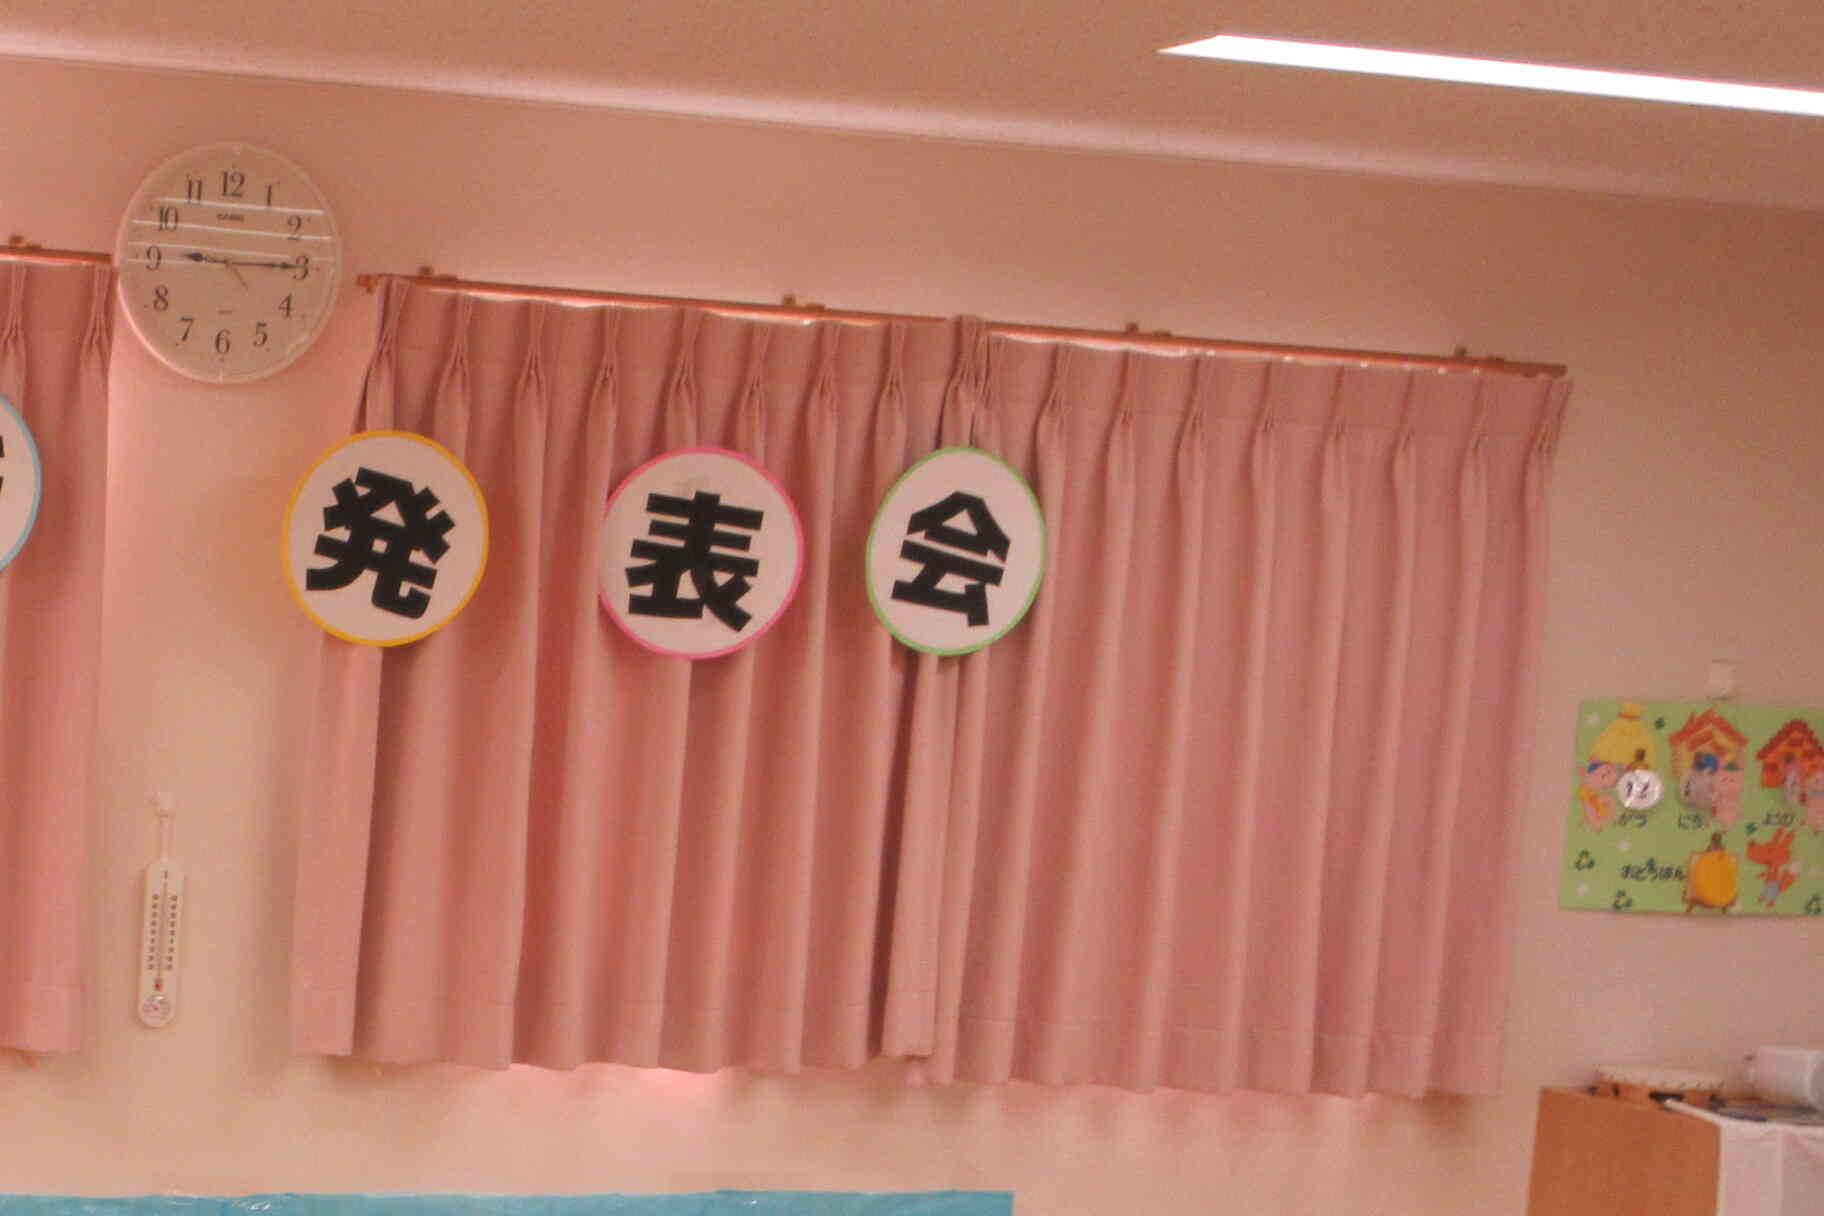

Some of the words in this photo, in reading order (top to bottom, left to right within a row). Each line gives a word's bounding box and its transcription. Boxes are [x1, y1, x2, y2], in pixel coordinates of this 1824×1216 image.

[186, 178, 203, 204] 11
[221, 171, 245, 198] 12
[265, 184, 273, 208] 1
[159, 207, 179, 232] 10
[287, 215, 302, 241] 2
[145, 246, 162, 271] 9
[293, 255, 310, 281] 3
[153, 285, 169, 312] 8
[278, 293, 293, 318] 4
[179, 316, 195, 343] 7
[253, 322, 268, 347] 5
[215, 330, 231, 355] 6
